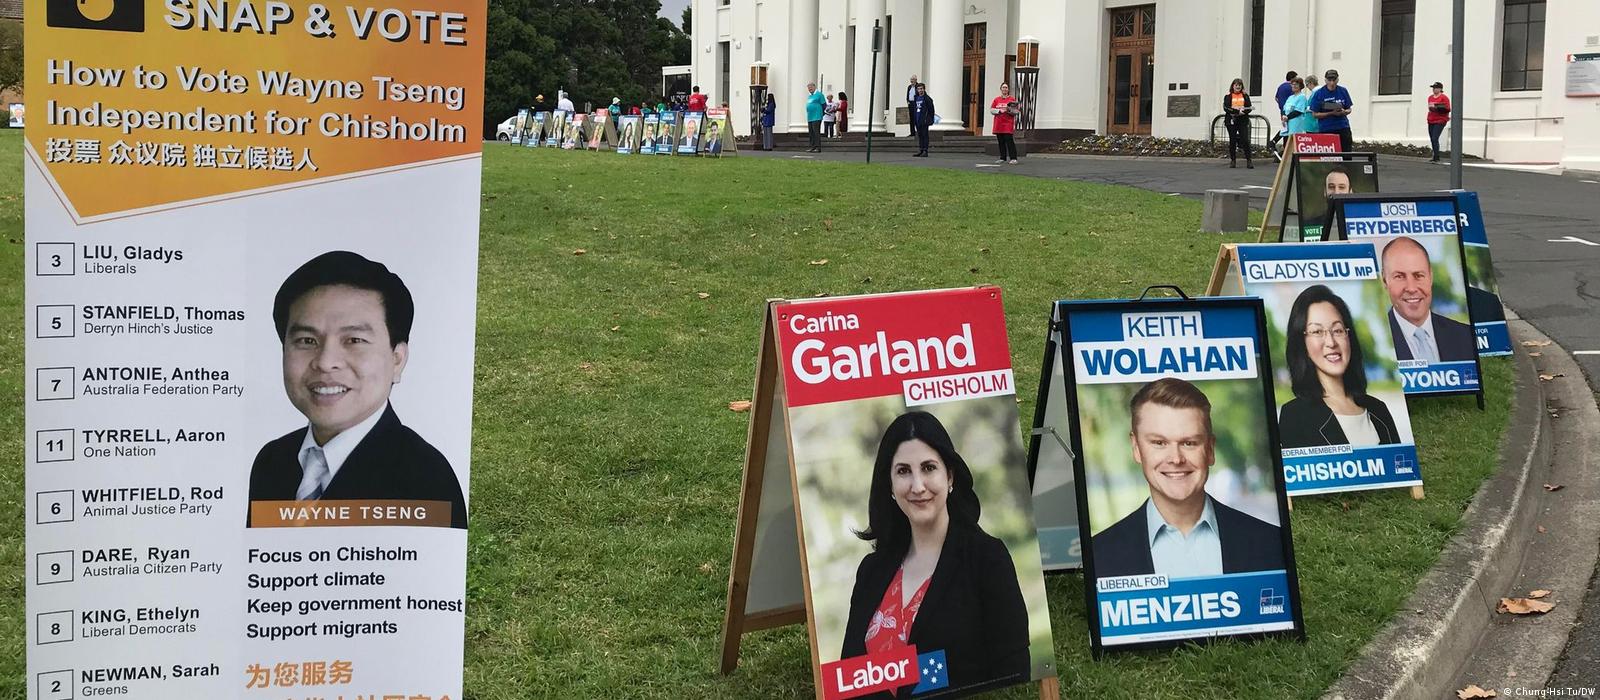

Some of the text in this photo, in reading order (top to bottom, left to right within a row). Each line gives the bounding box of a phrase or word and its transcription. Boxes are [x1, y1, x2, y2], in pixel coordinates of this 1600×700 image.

[164, 0, 467, 45] SNAP & VOTE
[47, 59, 466, 110] How to Vote Wayne Tseng
[47, 101, 467, 143] Independent for Chisholm
[1297, 142, 1336, 153] Garland
[46, 139, 319, 173] 投票 众议院 独立候选人
[1383, 204, 1416, 216] JOSH
[1304, 227, 1320, 235] VOTE
[1346, 218, 1456, 235] FRYDENBERG
[52, 255, 61, 267] 3
[84, 246, 183, 263] LIU, Gladys
[85, 263, 136, 274] Liberals
[1249, 261, 1373, 280] GLADYS LIU MP
[83, 306, 244, 322] STANFIELD, Thomas
[52, 317, 61, 329] 5
[85, 323, 213, 336] Derryn Hinch's Justice
[789, 311, 860, 335] Carina
[1127, 315, 1199, 338] KEITH
[791, 323, 977, 385] Garland
[1081, 345, 1248, 376] WOLAHAN
[82, 367, 229, 383] ANTONIE, Anthea
[52, 380, 61, 391] 7
[83, 384, 243, 397] Australia Federation Party
[908, 373, 1009, 401] CHISHOLM
[82, 429, 224, 444] TYRRELL, Aaron
[47, 440, 63, 451] 11
[84, 446, 155, 457] One Nation
[1281, 449, 1307, 457] EDERAL
[1308, 447, 1337, 455] MEMBER
[1284, 458, 1386, 484] CHISHOLM
[82, 487, 223, 503] WHITFIELD, Rod
[51, 503, 60, 514] 6
[83, 503, 212, 517] Animal Justice Party
[280, 507, 425, 520] WAYNE TSENG
[82, 547, 190, 563] DARE, Ryan
[249, 547, 417, 563] Focus on Chisholm
[51, 563, 60, 575] 9
[83, 562, 223, 577] Australia Citizen Party
[248, 572, 385, 591] Support climate
[1100, 575, 1167, 590] LIBERAL FOR
[248, 596, 462, 615] Keep government honest
[1101, 590, 1242, 628] MENZIES
[1259, 604, 1285, 615] LIBERAL
[82, 607, 200, 624] KING, Ethelyn
[51, 623, 60, 635] 8
[83, 623, 196, 638] Liberal Democrats
[247, 621, 397, 641] Support migrants
[82, 663, 219, 683] NEWMAN, Sarah
[245, 660, 353, 688] 为您服务
[836, 657, 910, 693] Labor
[52, 681, 60, 692] 2
[82, 686, 128, 696] Greens
